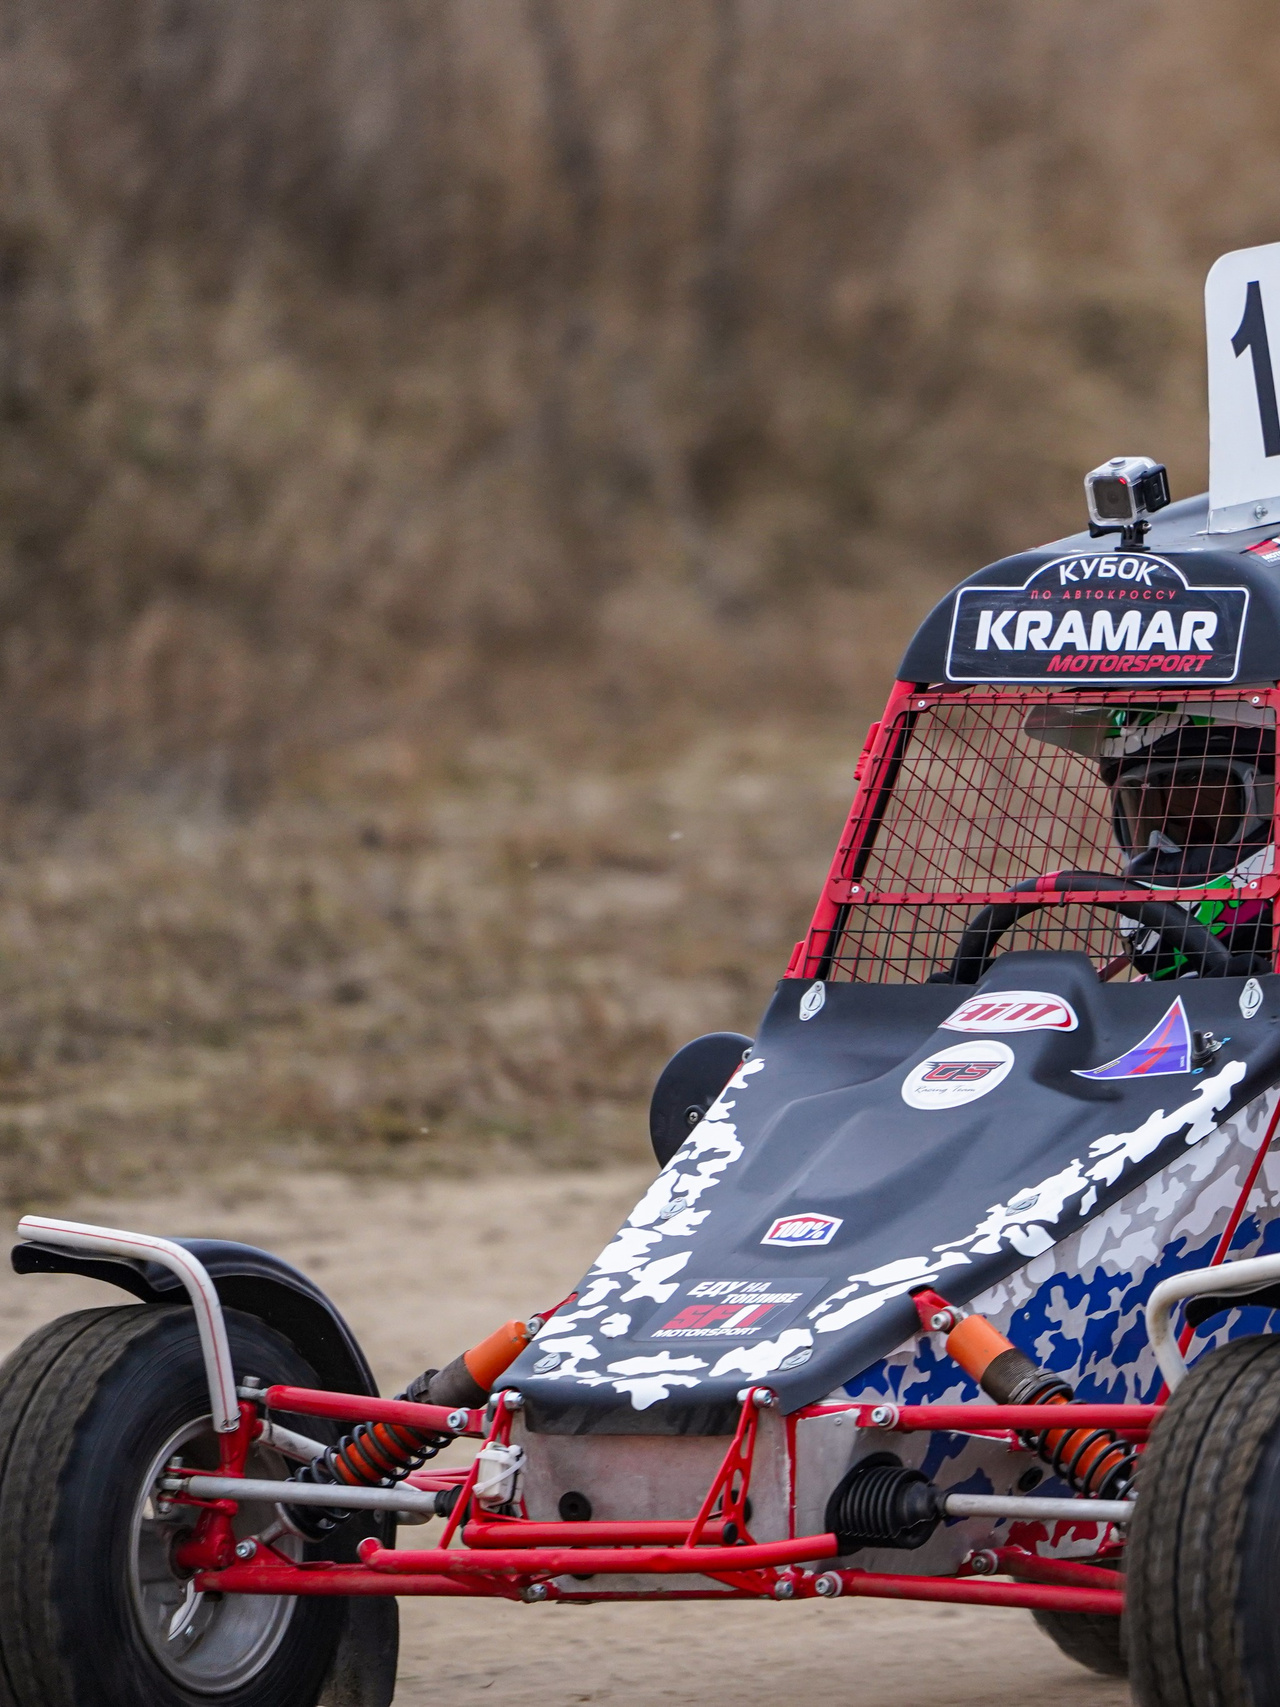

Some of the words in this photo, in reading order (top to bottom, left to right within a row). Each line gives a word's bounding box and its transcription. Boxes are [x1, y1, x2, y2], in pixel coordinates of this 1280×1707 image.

[1059, 556, 1161, 586] КУБОК
[1030, 589, 1053, 600] ПО
[1062, 589, 1177, 600] АВТОКРОССУ
[974, 610, 1219, 651] KRAMAR
[1046, 654, 1213, 673] MOTORSPORT
[922, 1060, 1004, 1082] GS
[914, 1085, 949, 1095] Racing
[950, 1084, 977, 1094] Team
[772, 1221, 831, 1240] 100%
[686, 1281, 749, 1298] ЕДУ
[740, 1281, 773, 1293] НА
[720, 1292, 804, 1305] ТОПЛИВЕ
[650, 1327, 762, 1338] MOTORSPORT
